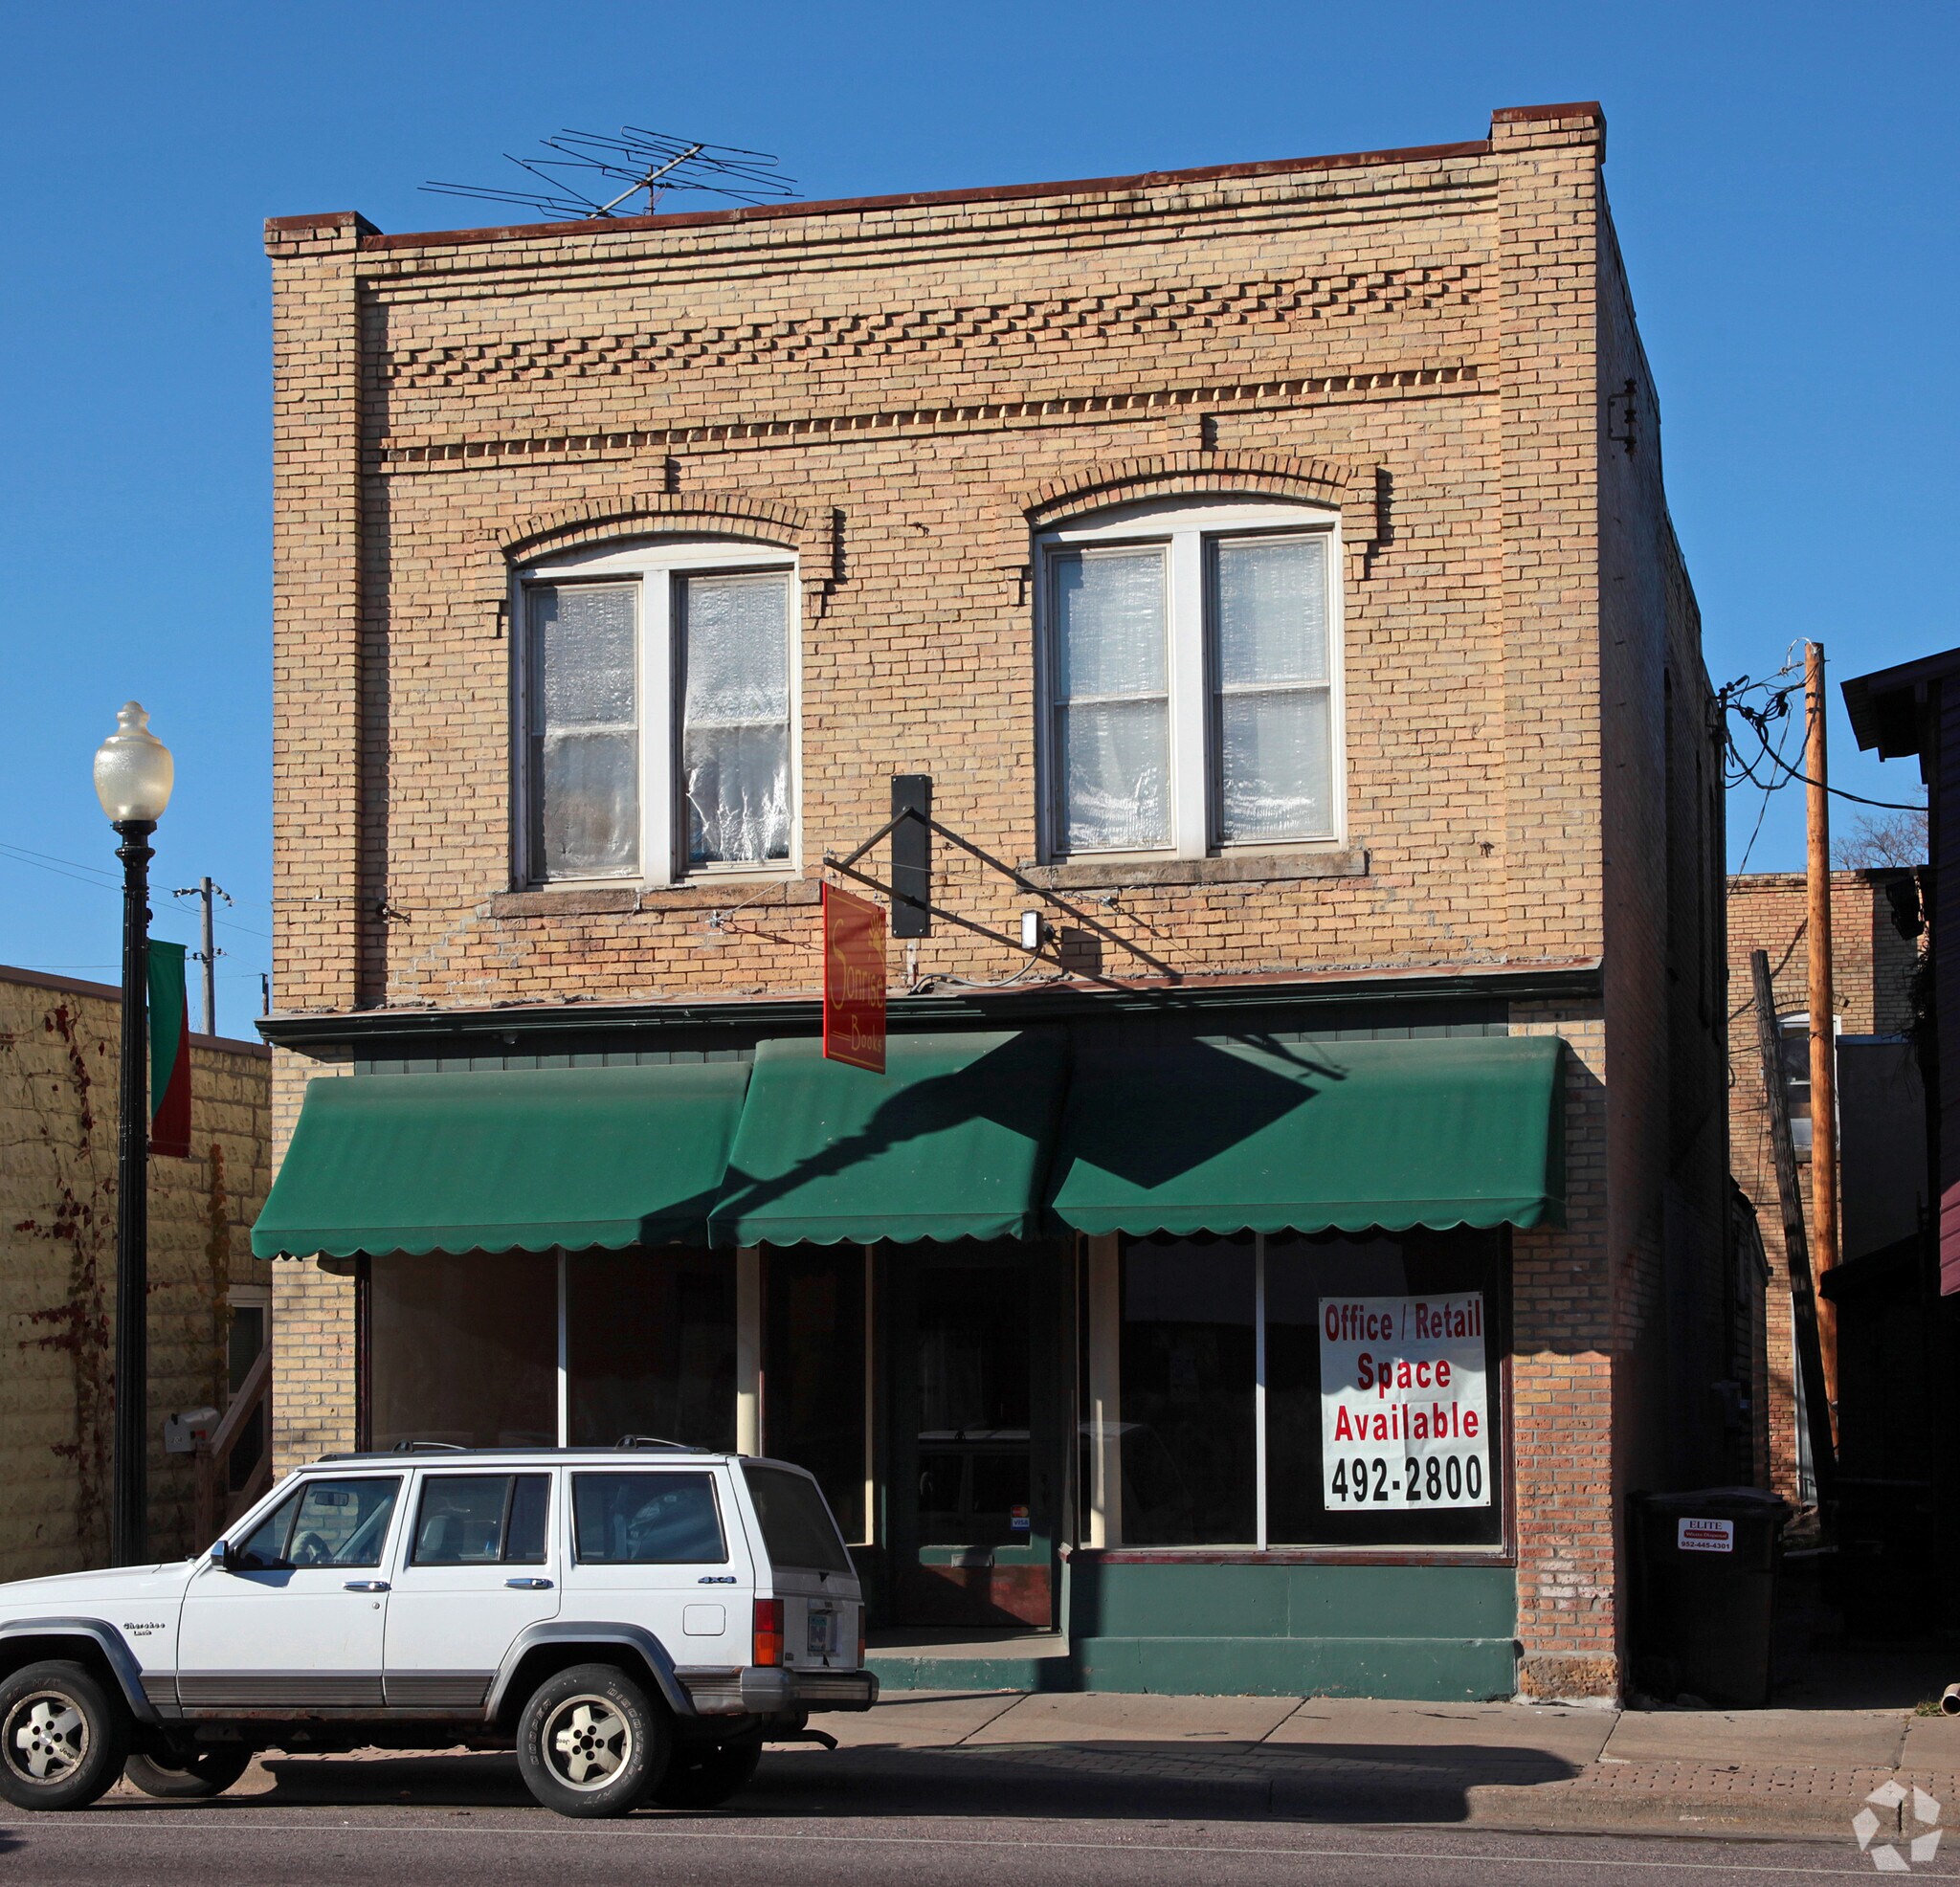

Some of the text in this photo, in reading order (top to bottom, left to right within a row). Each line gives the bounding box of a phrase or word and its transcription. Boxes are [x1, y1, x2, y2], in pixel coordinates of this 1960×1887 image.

[831, 918, 883, 1010] Sonrise
[851, 1014, 881, 1054] Books
[1325, 1299, 1481, 1342] Office / Retail
[1357, 1352, 1451, 1399] Space
[1334, 1401, 1480, 1441] Available
[1331, 1454, 1482, 1502] 492-2800
[1681, 1541, 1730, 1549] 952-445-4301
[1689, 1521, 1723, 1530] ELITE
[529, 1698, 552, 1765] COOPER
[607, 1687, 644, 1787] DISCOVERER
[59, 1747, 75, 1760] Jeep
